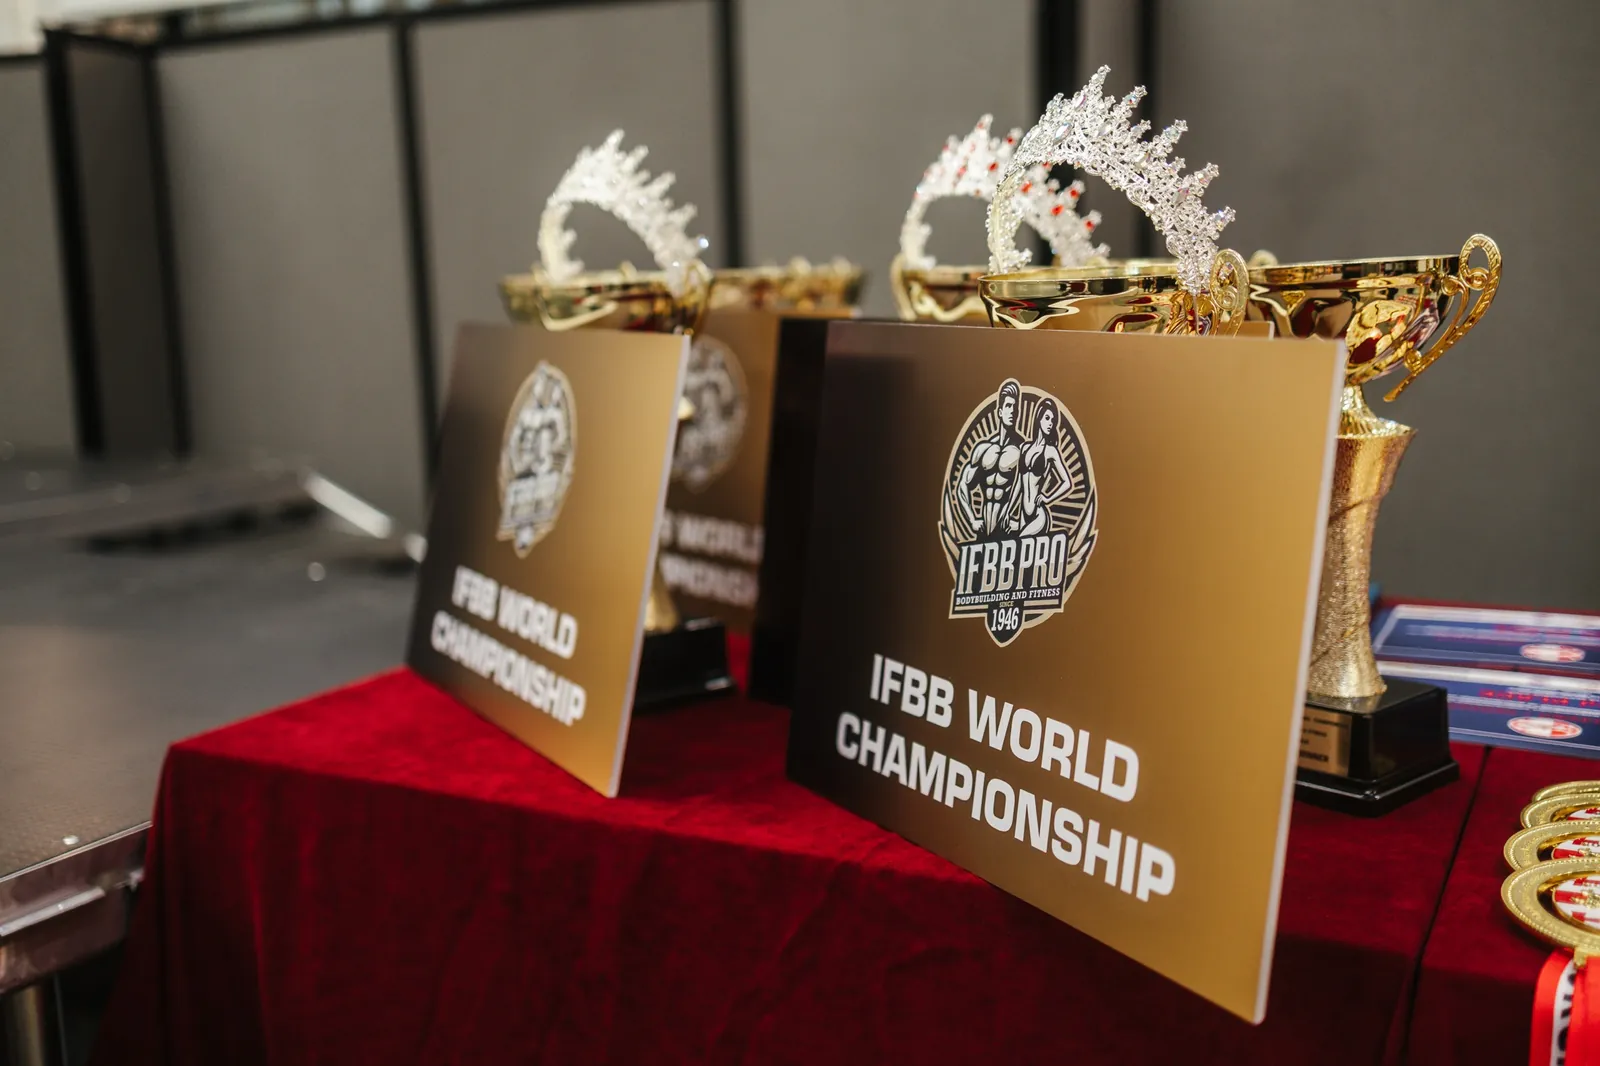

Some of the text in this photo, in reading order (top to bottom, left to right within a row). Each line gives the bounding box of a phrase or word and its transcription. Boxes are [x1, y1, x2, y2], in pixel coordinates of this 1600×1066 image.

[956, 534, 1067, 595] IFBB PRO
[956, 588, 1060, 605] BODYBUILDING AND FITNESS
[497, 585, 578, 659] WORLD
[991, 607, 1019, 631] 1946
[431, 610, 587, 727] CHAMPIONSHIP
[870, 653, 1139, 803] IFBB WORLD
[836, 711, 1175, 902] CHAMPIONSHIP
